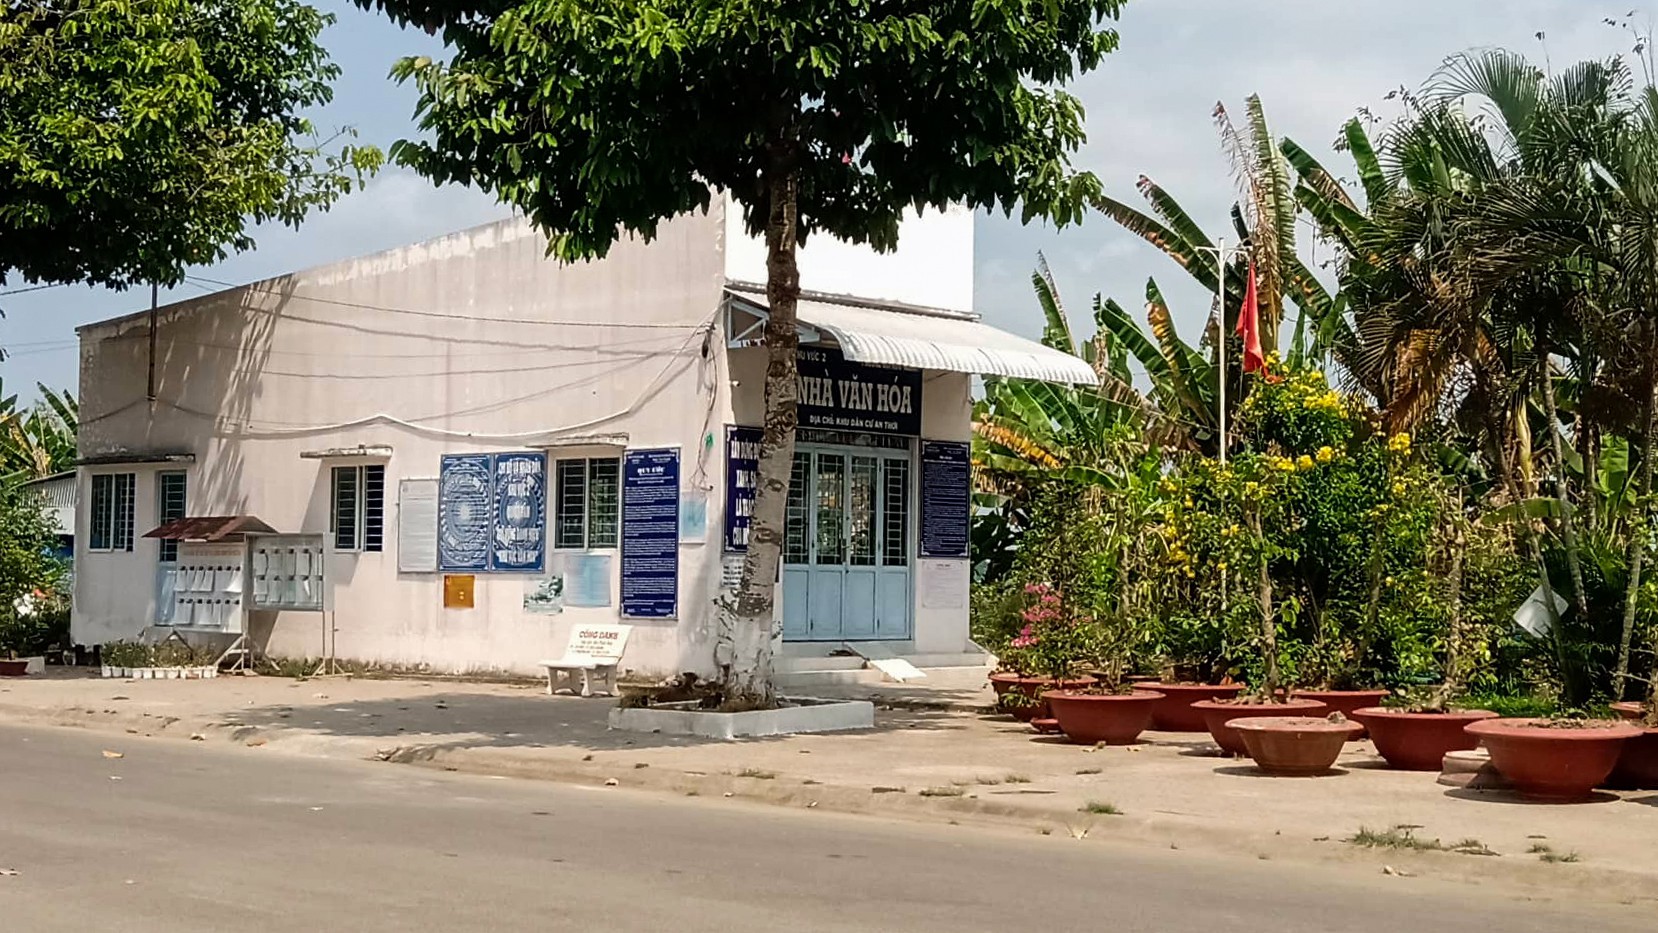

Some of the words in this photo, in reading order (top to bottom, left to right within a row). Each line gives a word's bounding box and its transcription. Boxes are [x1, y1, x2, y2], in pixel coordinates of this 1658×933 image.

[797, 350, 805, 360] HU
[822, 352, 826, 362] 2
[797, 368, 834, 407] NHÀ
[838, 373, 873, 411] VĂN
[877, 375, 912, 414] HÓA
[836, 417, 850, 426] KHU
[874, 420, 883, 429] AN
